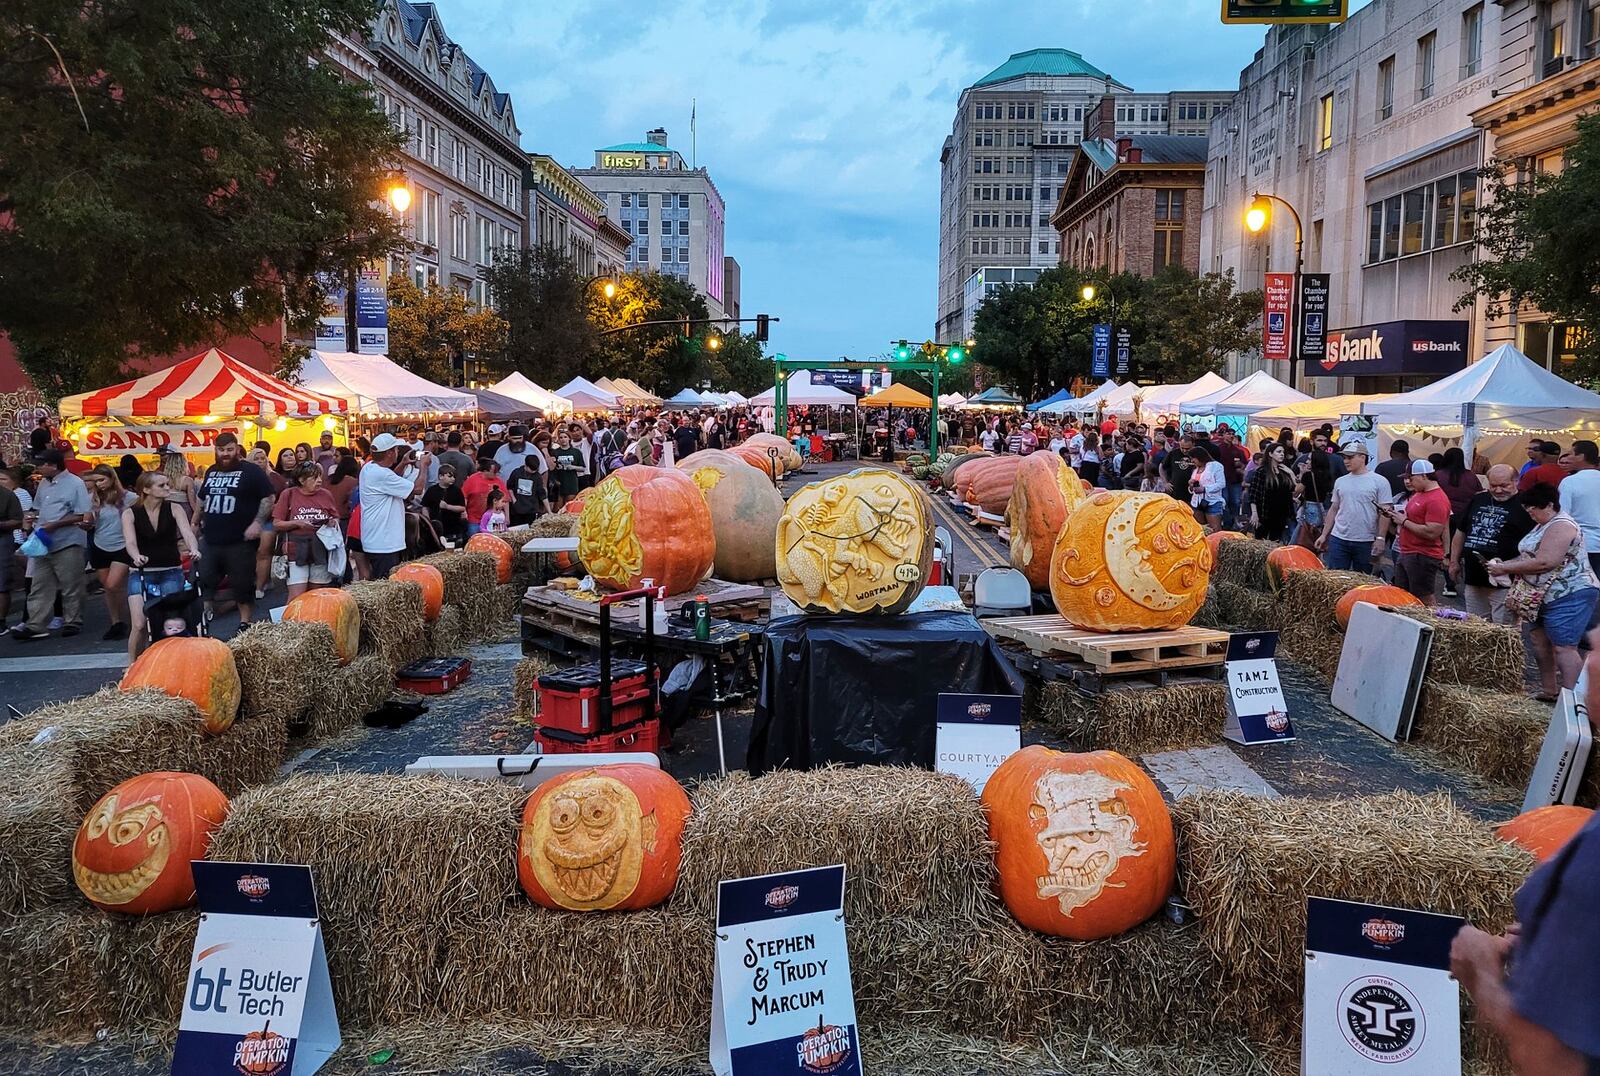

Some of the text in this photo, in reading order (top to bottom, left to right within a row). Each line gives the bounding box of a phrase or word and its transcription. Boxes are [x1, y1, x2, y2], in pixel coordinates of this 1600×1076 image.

[1305, 302, 1313, 310] for
[86, 430, 171, 450] SAND
[204, 477, 241, 488] PEOPLE
[855, 582, 899, 601] WORTMAN
[697, 607, 706, 618] G
[1237, 670, 1270, 682] TAMZ
[940, 753, 1007, 763] COURTYAR
[236, 877, 269, 886] OPERATION
[237, 883, 270, 892] PUMPKIN
[765, 886, 799, 899] OPERATION
[765, 891, 799, 905] PUMPKIN
[1361, 922, 1405, 931] OPERATION
[1361, 928, 1404, 938] PUMPKIN
[743, 933, 815, 968] STEPHEN
[239, 968, 302, 993] Butler
[753, 959, 828, 992] & TRUDY
[1367, 978, 1394, 986] CUSTOM
[189, 967, 232, 1013] bt
[237, 993, 284, 1016] Tech
[747, 989, 824, 1025] MARCUM
[1354, 987, 1408, 1011] INDEPENDENT
[1350, 1015, 1369, 1043] SHEET
[1402, 1023, 1412, 1040] LLC
[235, 1037, 290, 1053] OPERATION
[796, 1025, 849, 1053] OPERATION
[233, 1049, 289, 1066] PUMPKIN
[798, 1037, 851, 1067] PUMPKIN
[1350, 1037, 1414, 1061] METAL FABRICATORS
